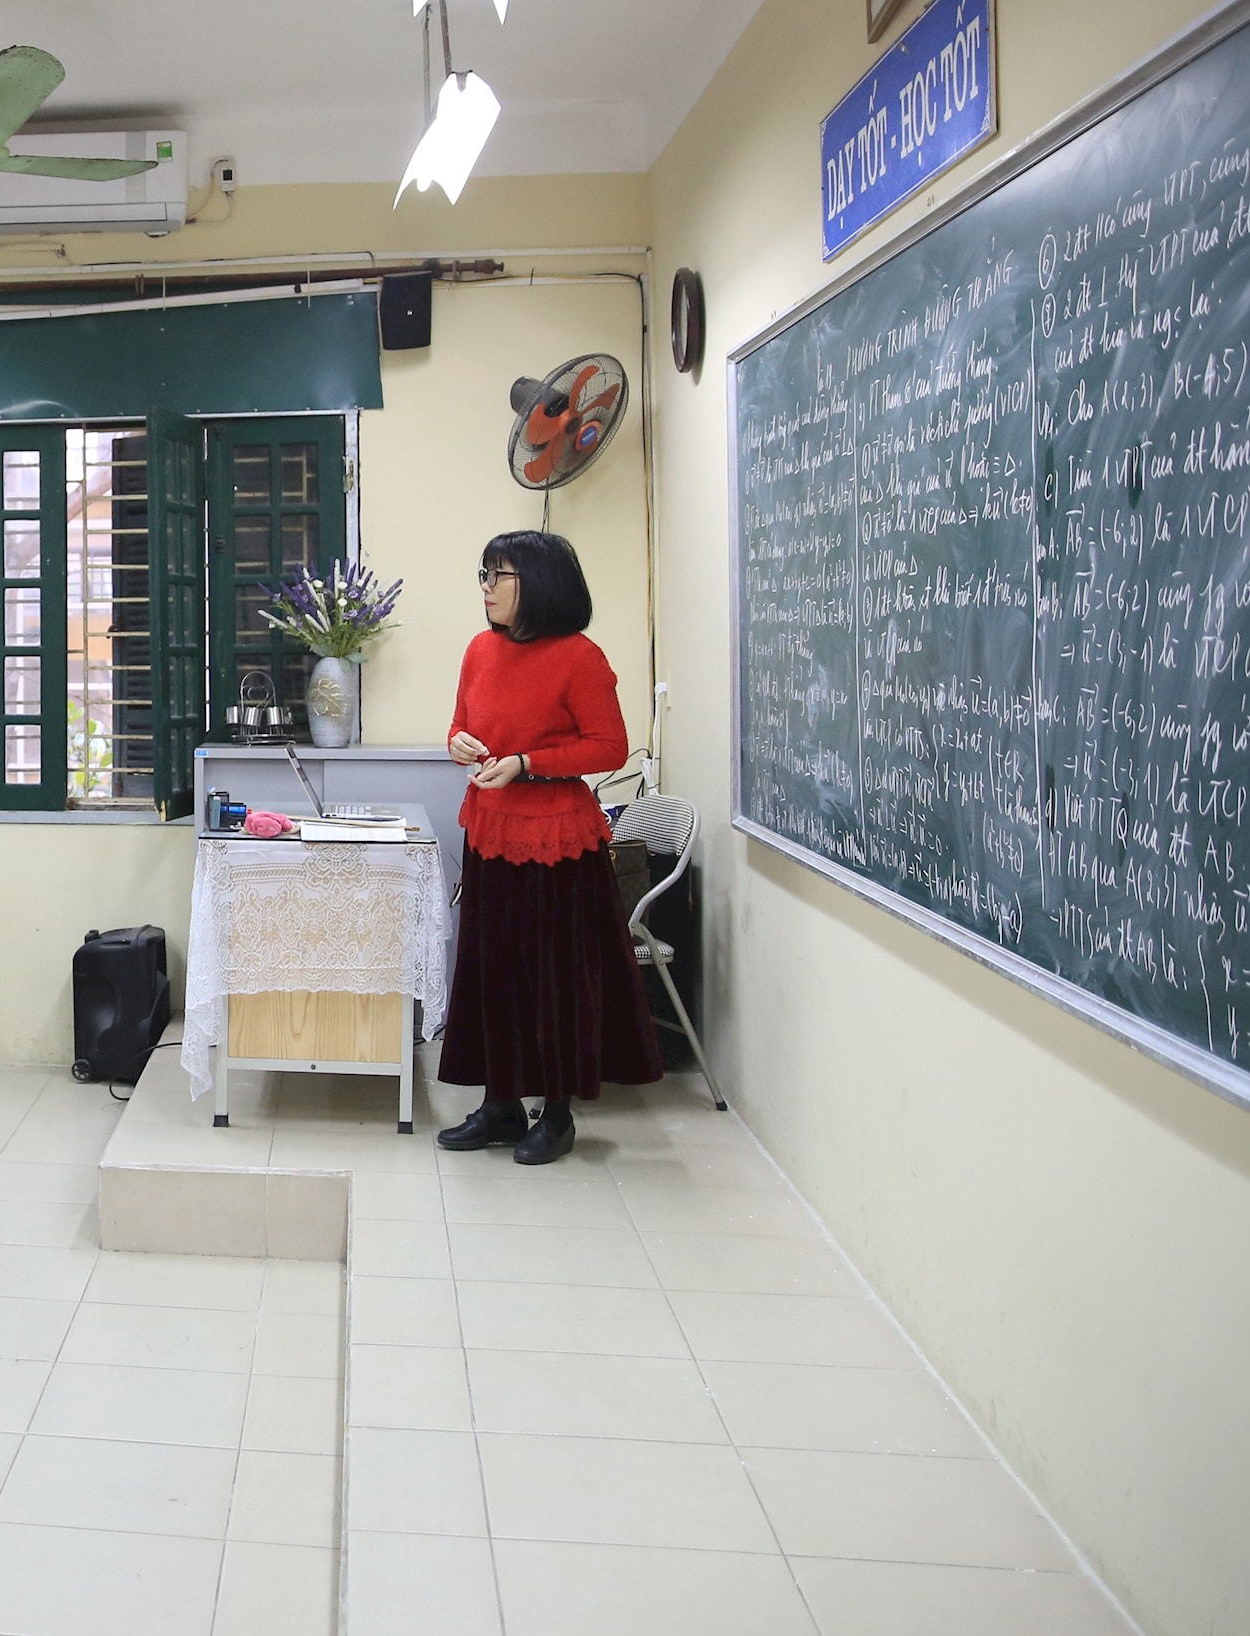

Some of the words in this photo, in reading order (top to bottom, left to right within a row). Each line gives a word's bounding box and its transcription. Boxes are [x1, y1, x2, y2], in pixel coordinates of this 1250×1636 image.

[827, 137, 856, 230] DẠY
[857, 78, 888, 194] TỐT
[899, 56, 938, 167] HỌC
[940, 0, 981, 124] TỐT
